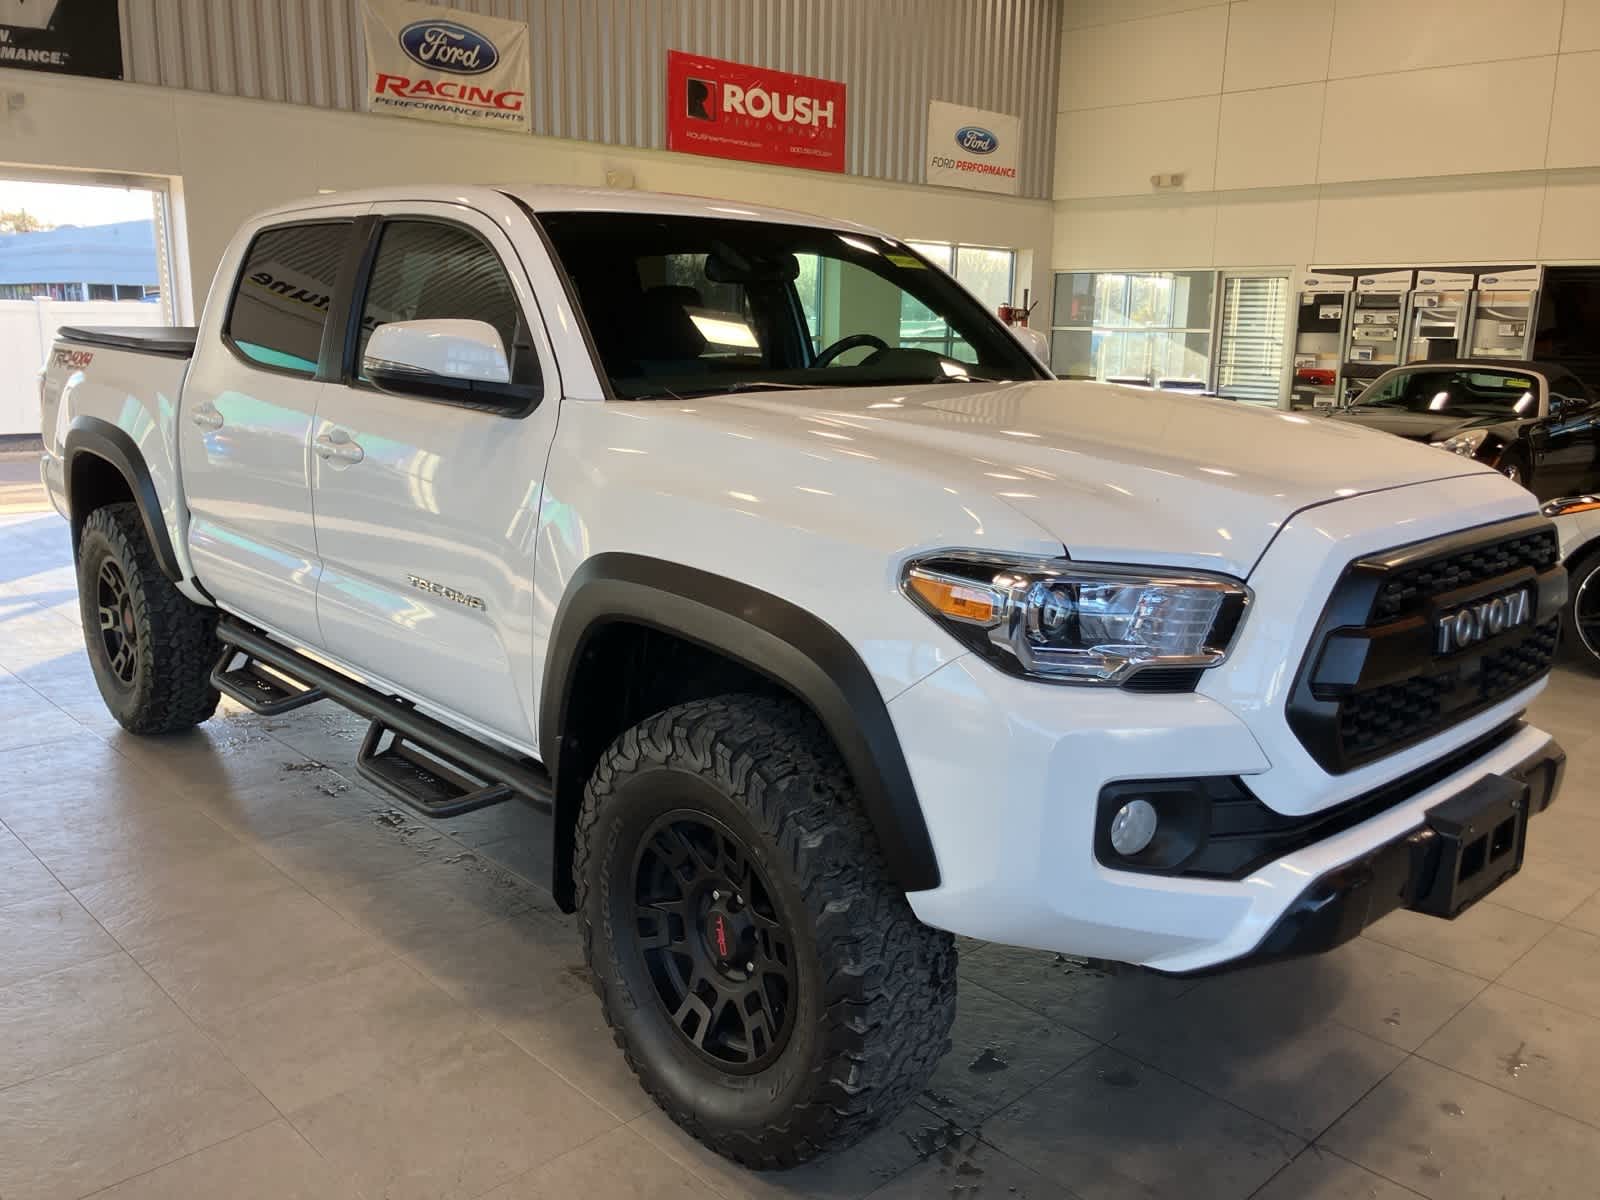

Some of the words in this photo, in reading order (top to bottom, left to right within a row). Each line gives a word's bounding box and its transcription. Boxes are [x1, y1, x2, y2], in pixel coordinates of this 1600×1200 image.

[419, 27, 480, 68] Ford
[375, 72, 525, 111] RACING
[375, 96, 484, 118] PERFORMANCE
[484, 111, 525, 122] PARTS
[722, 82, 835, 129] ROUSH
[963, 130, 991, 151] Ford
[931, 156, 956, 169] FORD
[955, 160, 1017, 179] PERFORMANCE
[1437, 589, 1530, 654] TOYOTA
[715, 915, 728, 957] TRD
